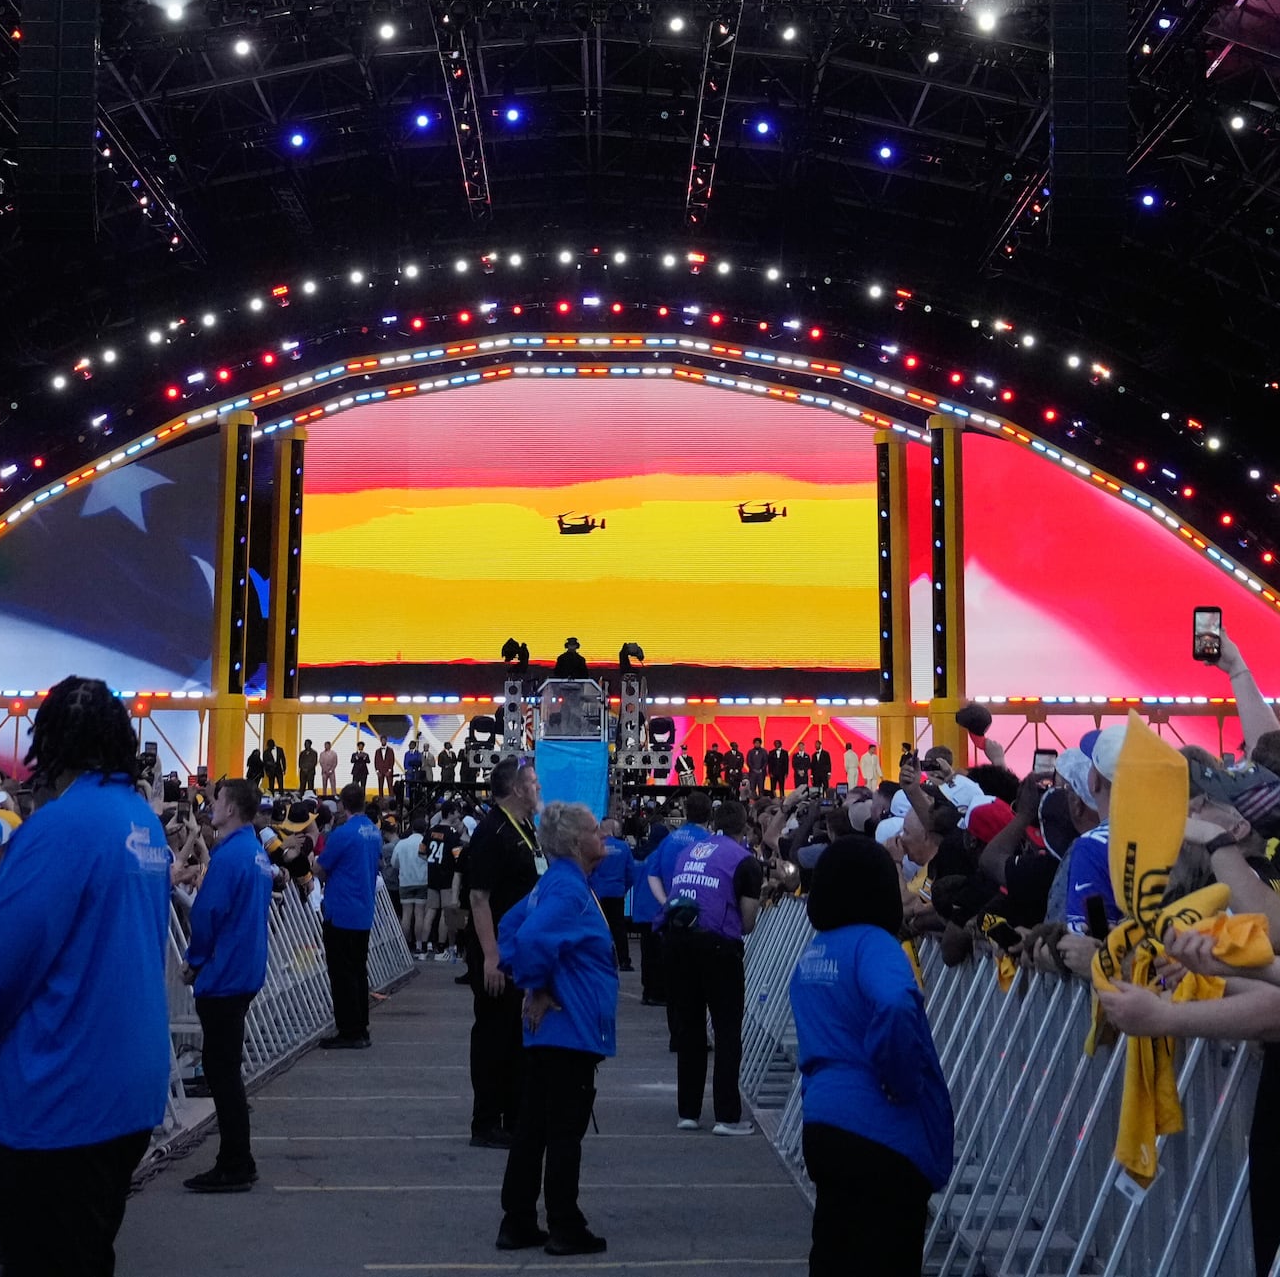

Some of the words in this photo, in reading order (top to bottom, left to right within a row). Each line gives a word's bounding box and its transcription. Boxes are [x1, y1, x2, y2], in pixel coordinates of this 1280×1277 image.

[427, 840, 445, 864] 24
[683, 861, 706, 873] GAME
[671, 873, 720, 889] PRESENTATION
